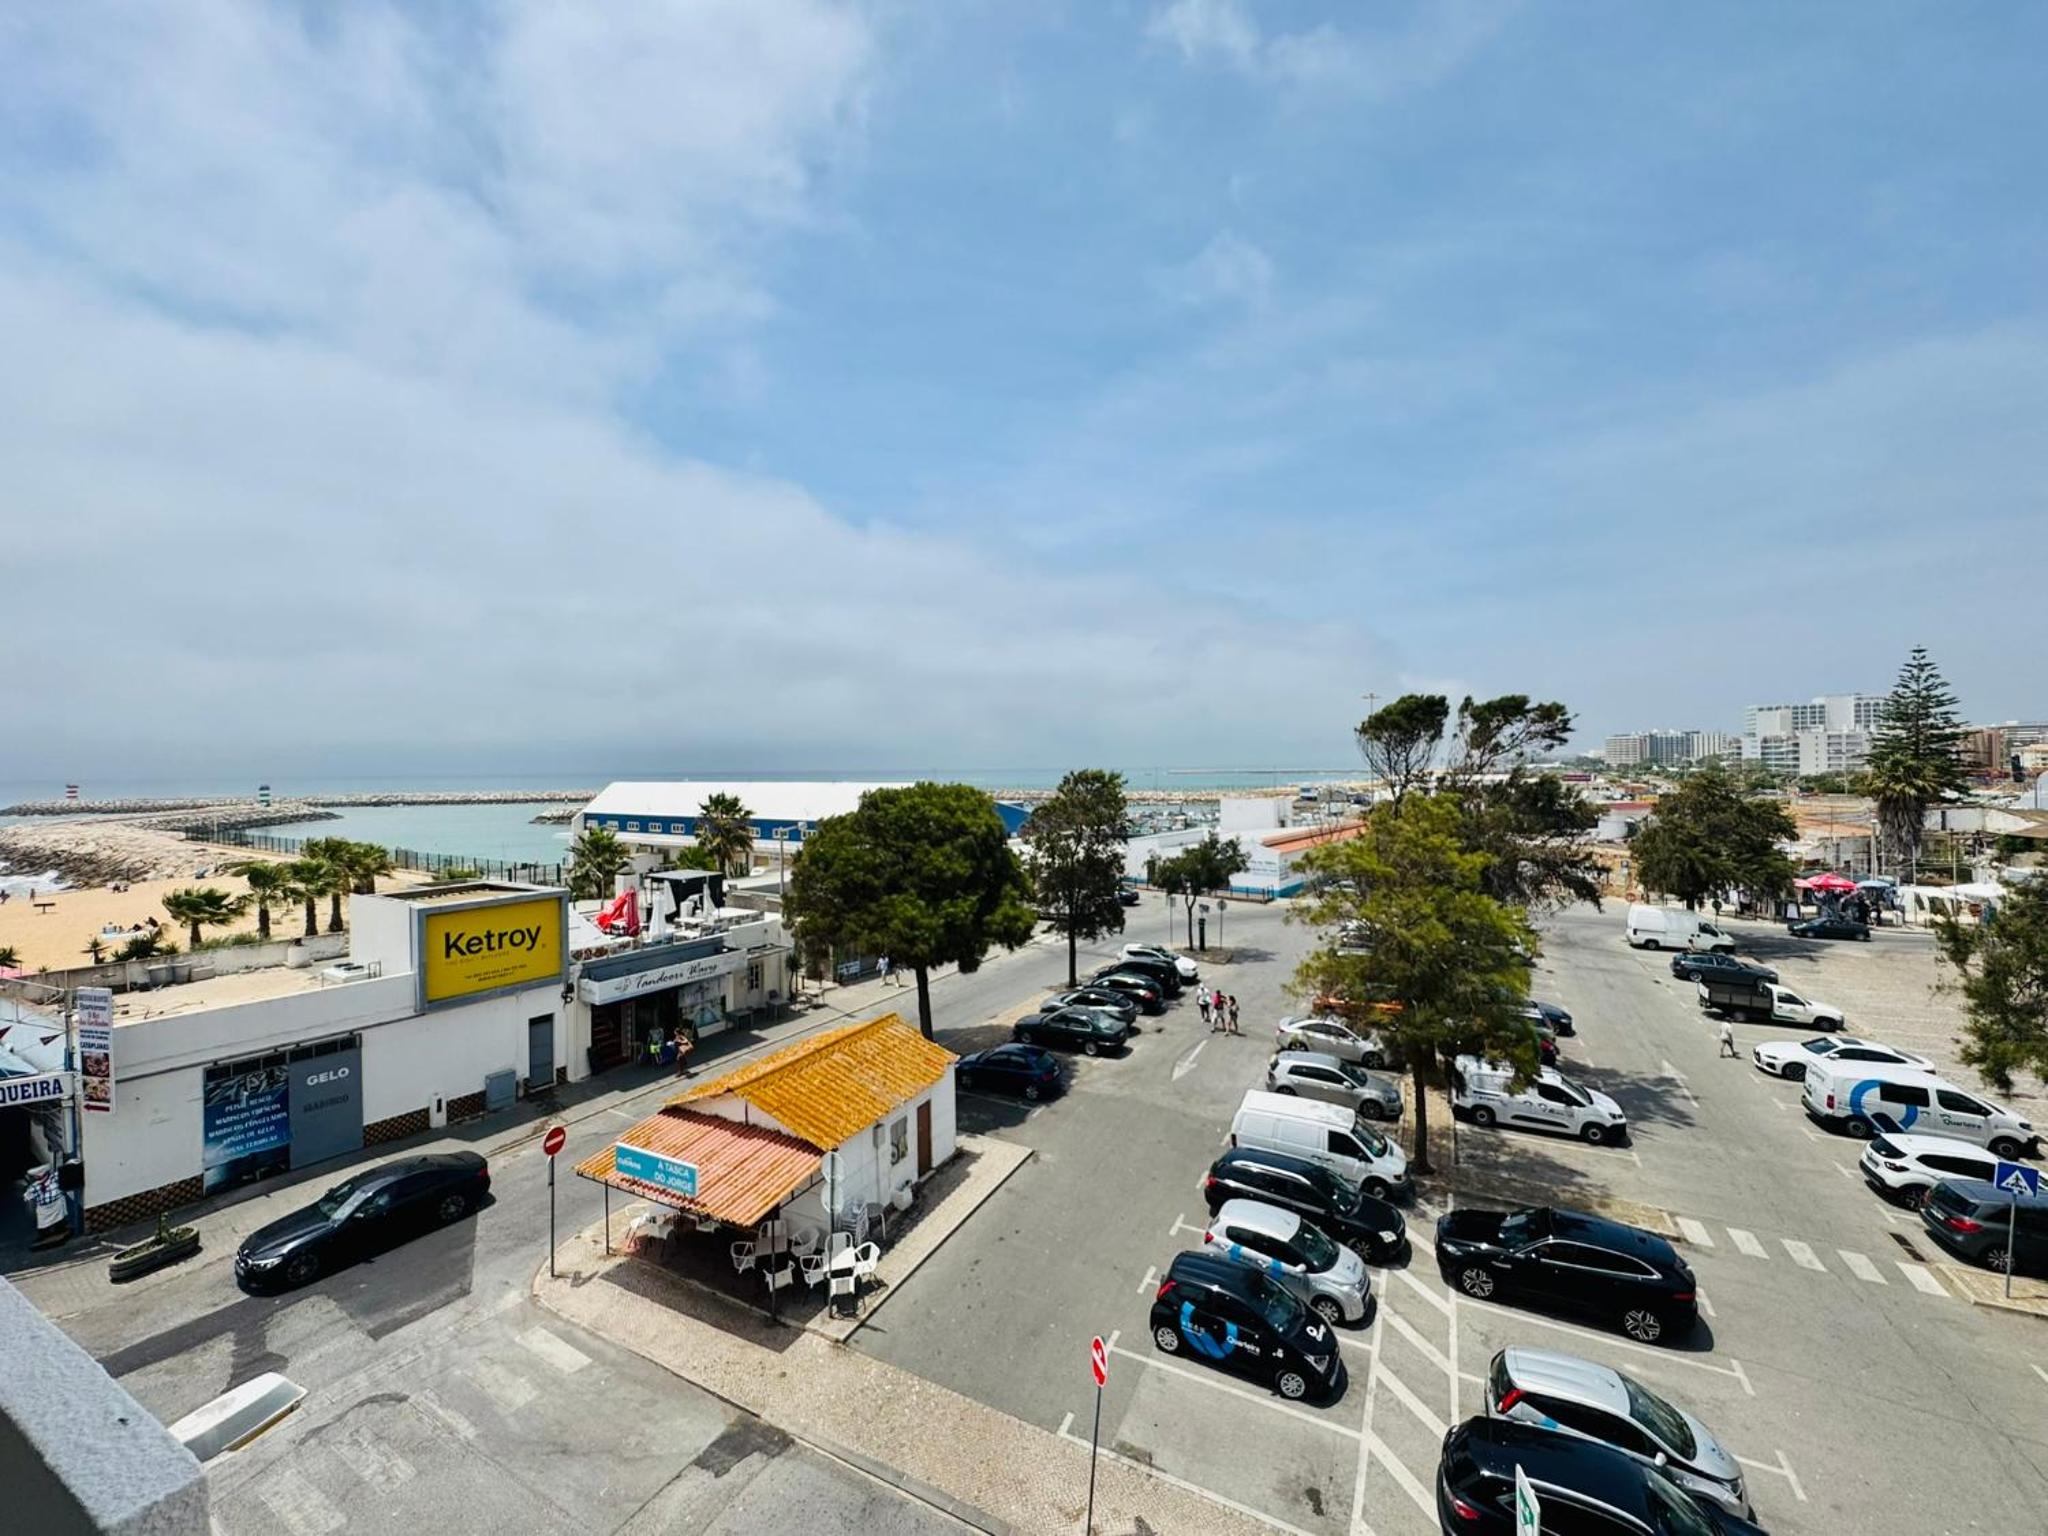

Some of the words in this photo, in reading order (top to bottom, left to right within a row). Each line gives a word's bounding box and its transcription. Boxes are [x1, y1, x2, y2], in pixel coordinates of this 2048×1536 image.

[444, 925, 541, 959] Ketroy
[306, 1067, 349, 1086] GELO
[657, 1160, 663, 1170] A
[665, 1162, 689, 1176] TASCA
[654, 1171, 667, 1183] DO
[667, 1175, 694, 1192] JORGE
